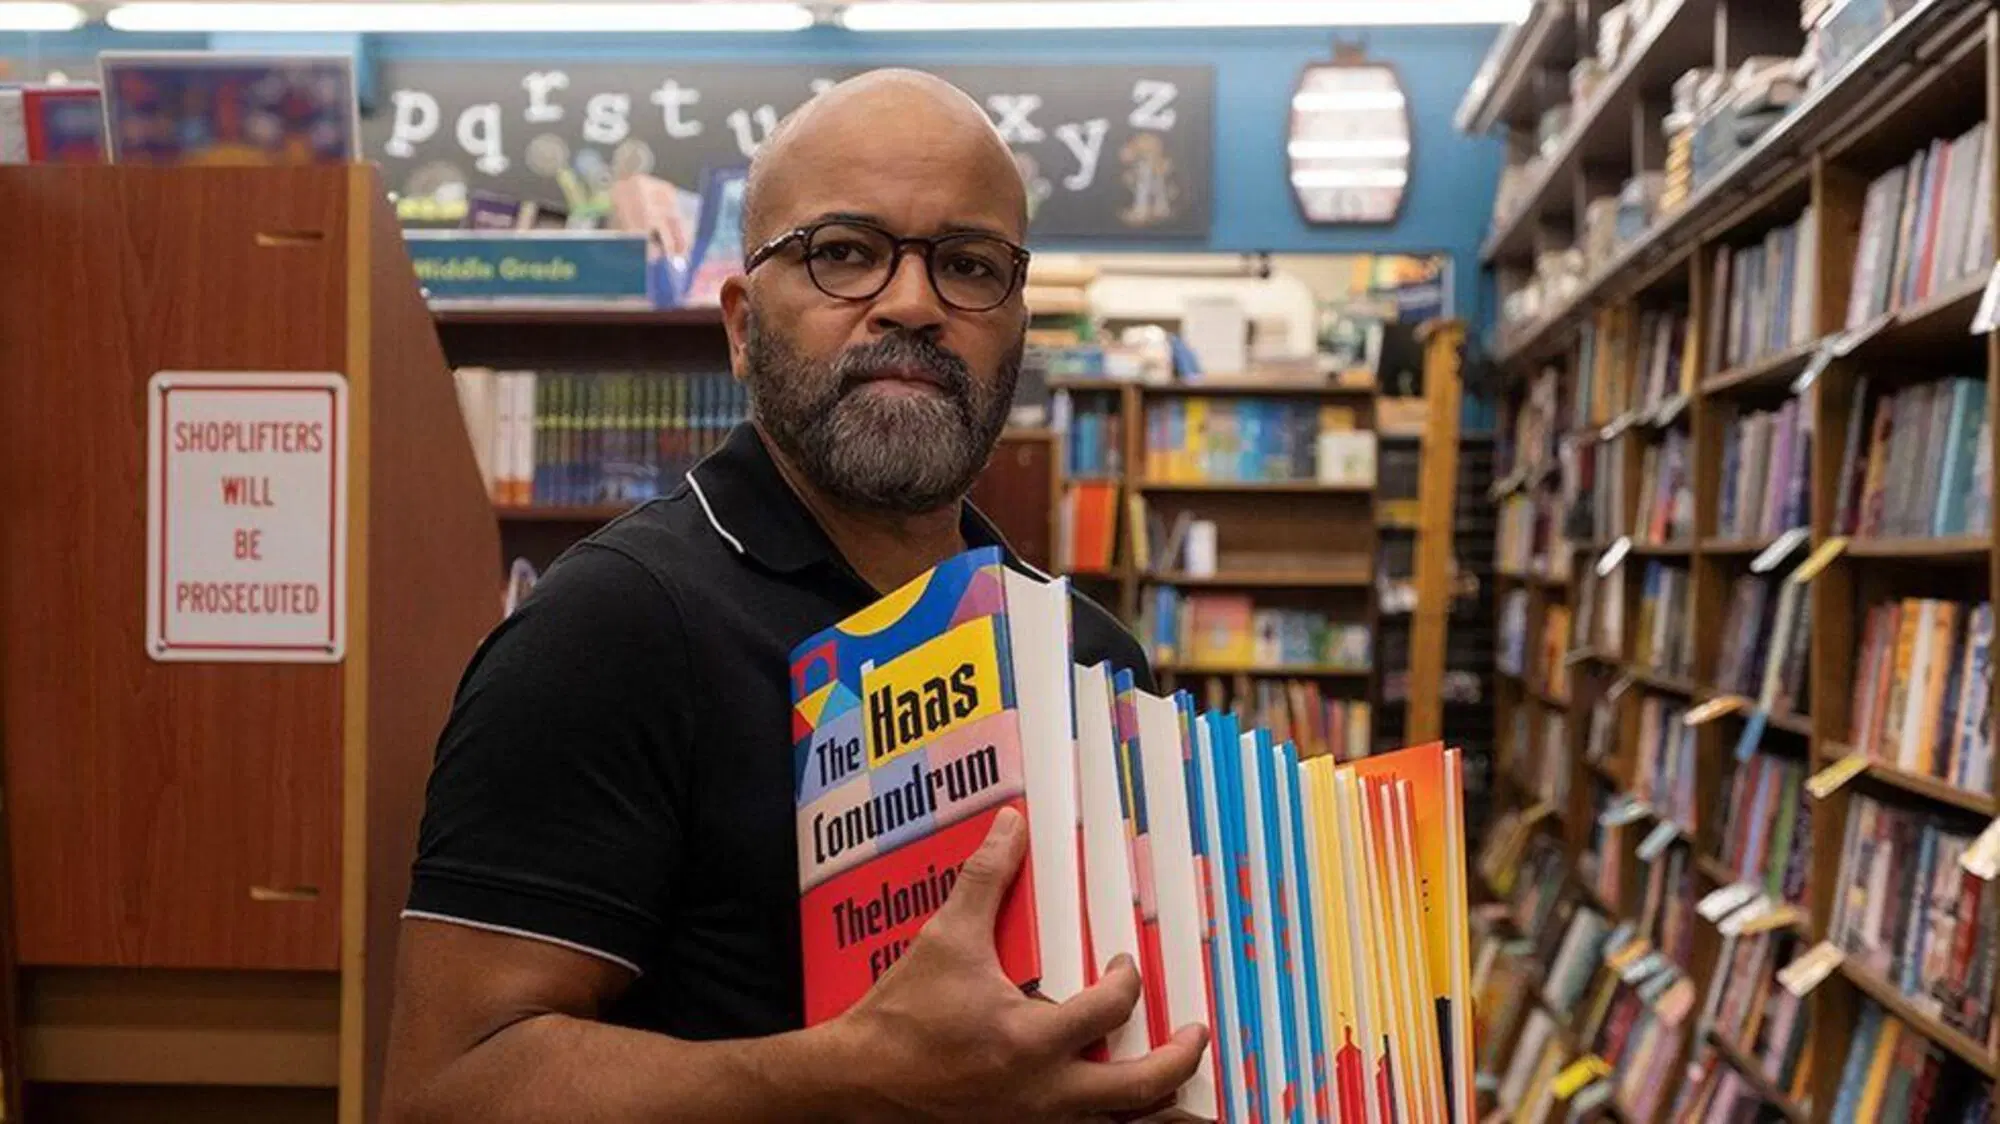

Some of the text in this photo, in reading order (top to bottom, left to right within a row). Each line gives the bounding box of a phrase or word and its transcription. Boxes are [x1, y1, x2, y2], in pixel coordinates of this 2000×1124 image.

[499, 256, 577, 281] Grade
[174, 421, 323, 453] SHOPLIFTERS
[221, 476, 274, 506] WILL
[234, 528, 263, 561] BE
[175, 583, 320, 614] PROSECUTED
[816, 663, 980, 787] The Haas
[813, 744, 1000, 865] Conundrum
[832, 863, 965, 949] Thelonio
